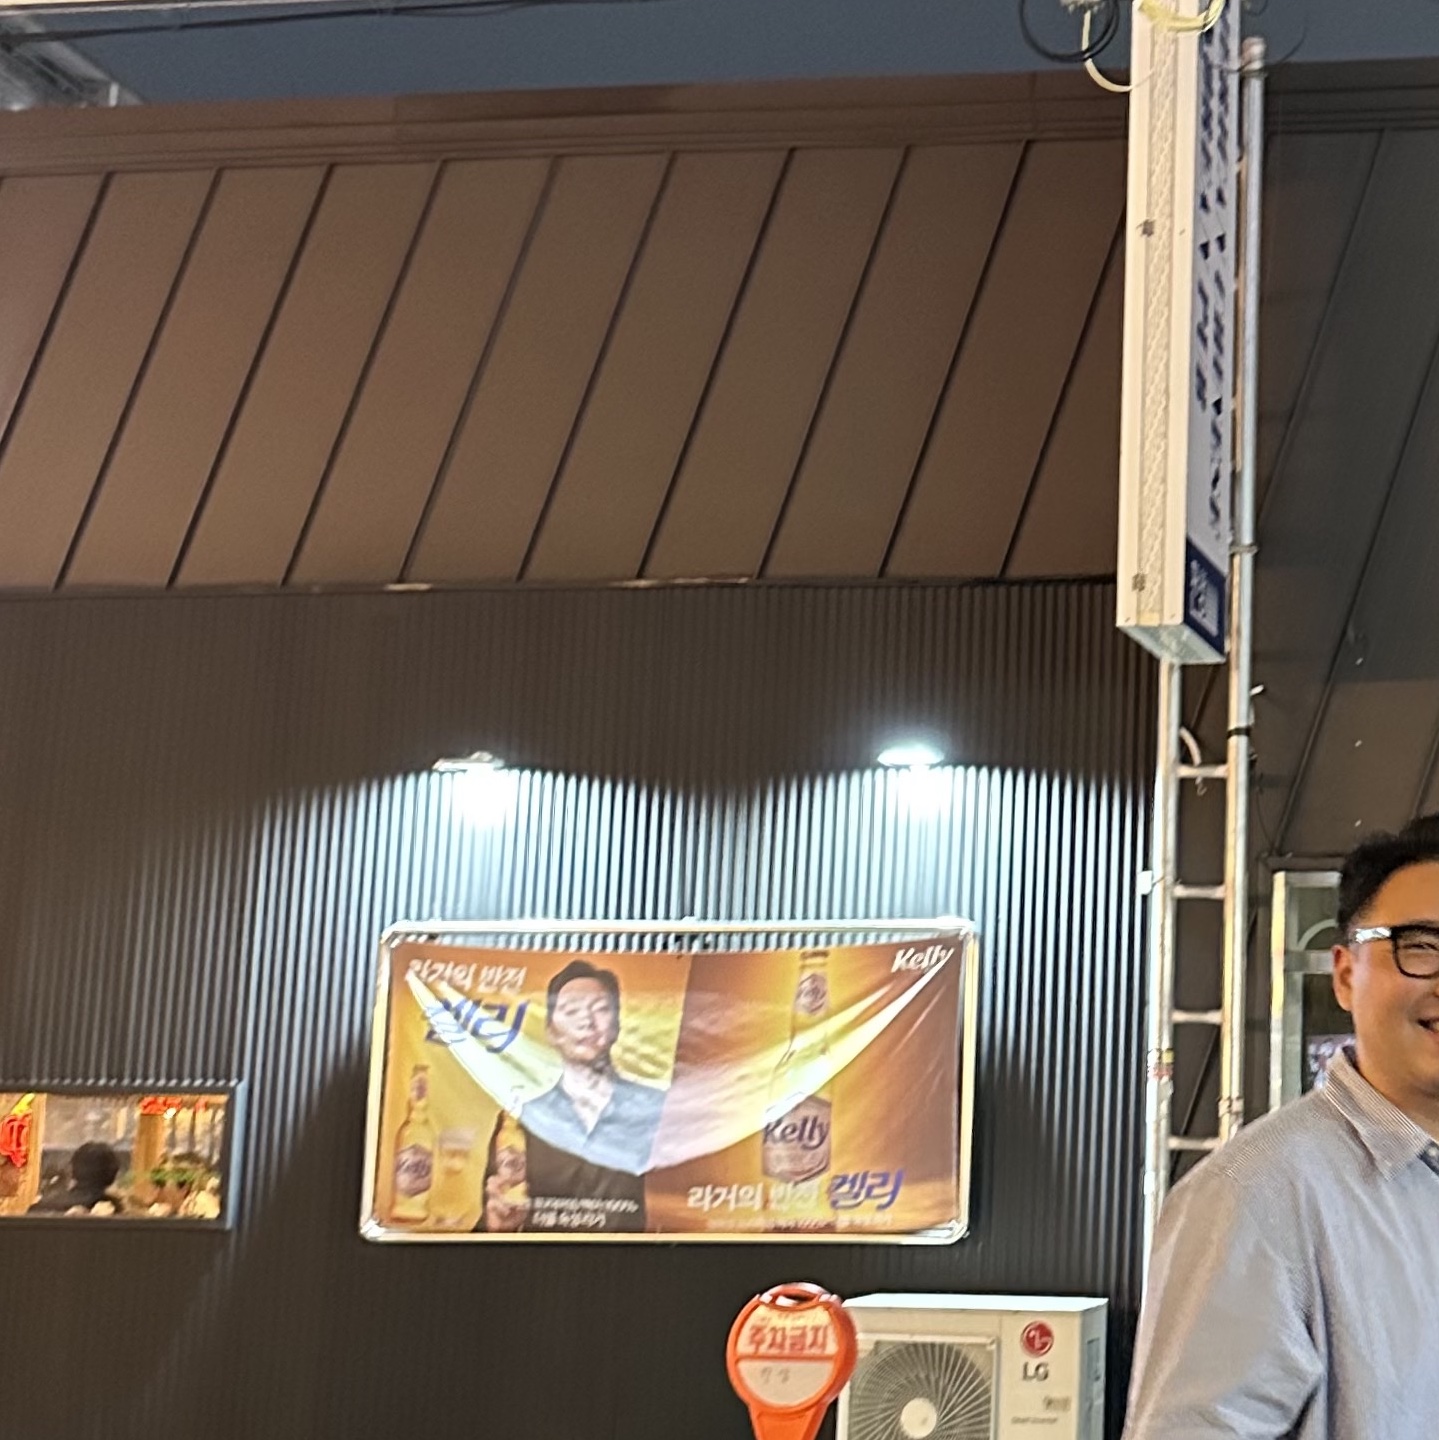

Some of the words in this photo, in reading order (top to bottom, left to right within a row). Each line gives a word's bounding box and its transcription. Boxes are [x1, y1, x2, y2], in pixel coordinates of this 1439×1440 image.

[891, 945, 954, 973] Kelly
[763, 1115, 830, 1150] Kelly
[687, 1183, 764, 1212] 라거의
[750, 1324, 828, 1355] 주차금지
[1022, 1361, 1050, 1381] LG
